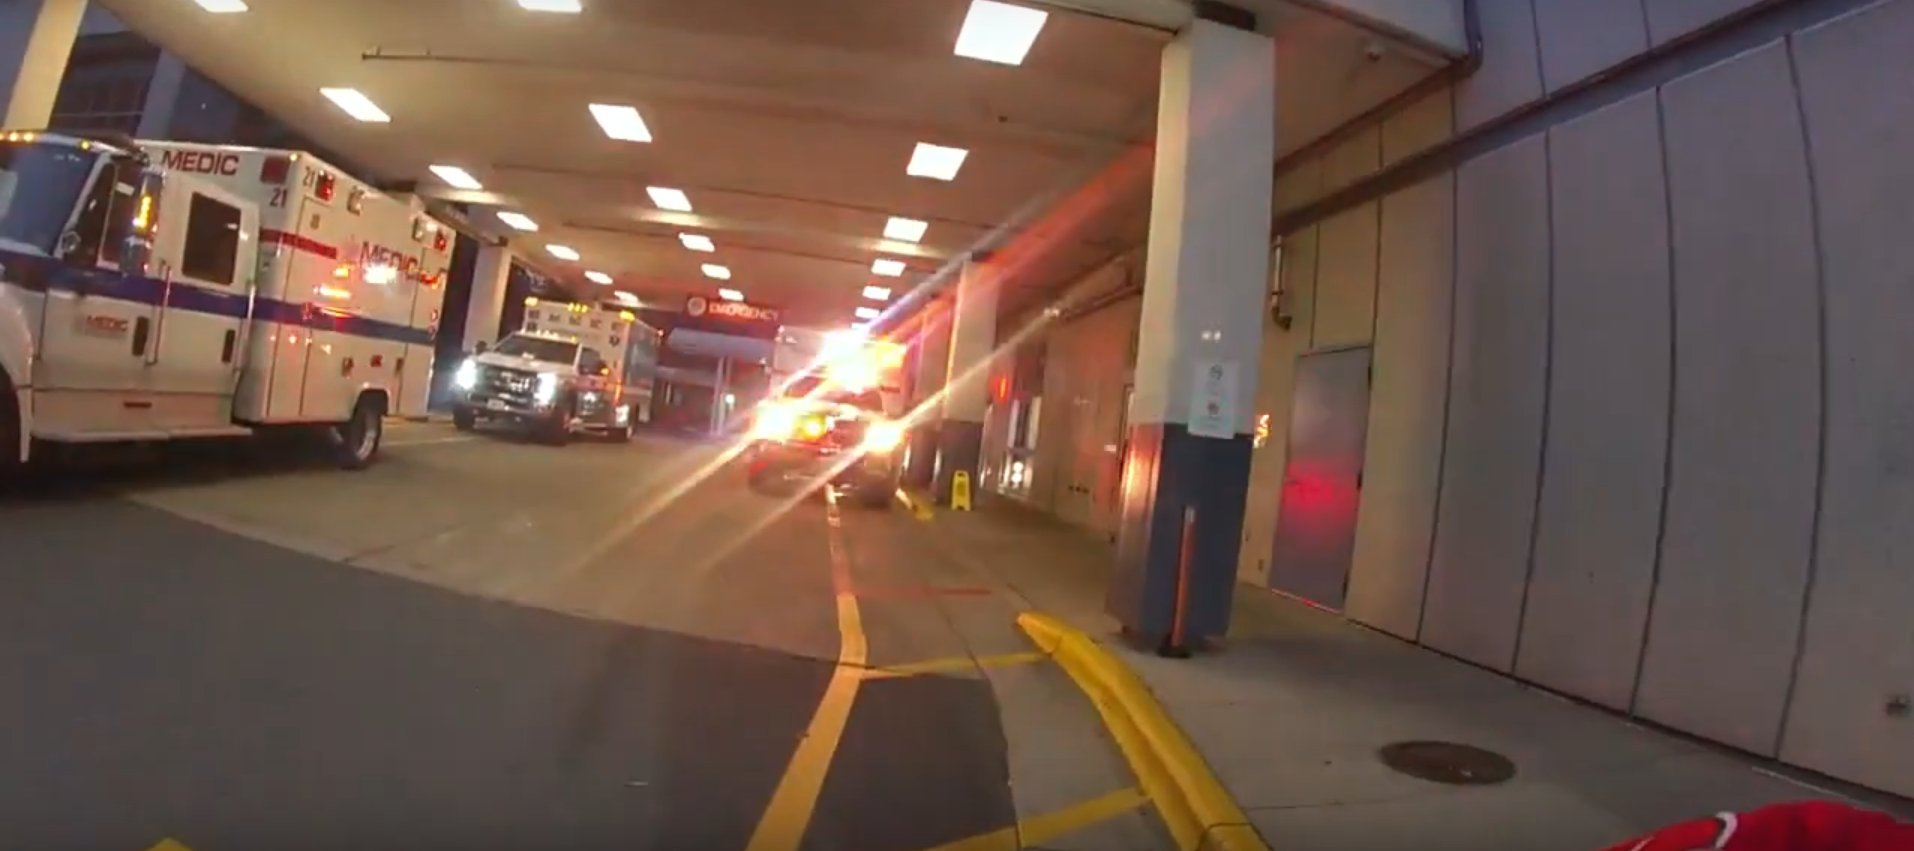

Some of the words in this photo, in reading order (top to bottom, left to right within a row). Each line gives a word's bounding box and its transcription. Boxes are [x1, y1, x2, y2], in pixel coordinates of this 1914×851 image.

[162, 150, 239, 176] MEDIC
[303, 165, 316, 188] 21
[269, 188, 288, 208] 21
